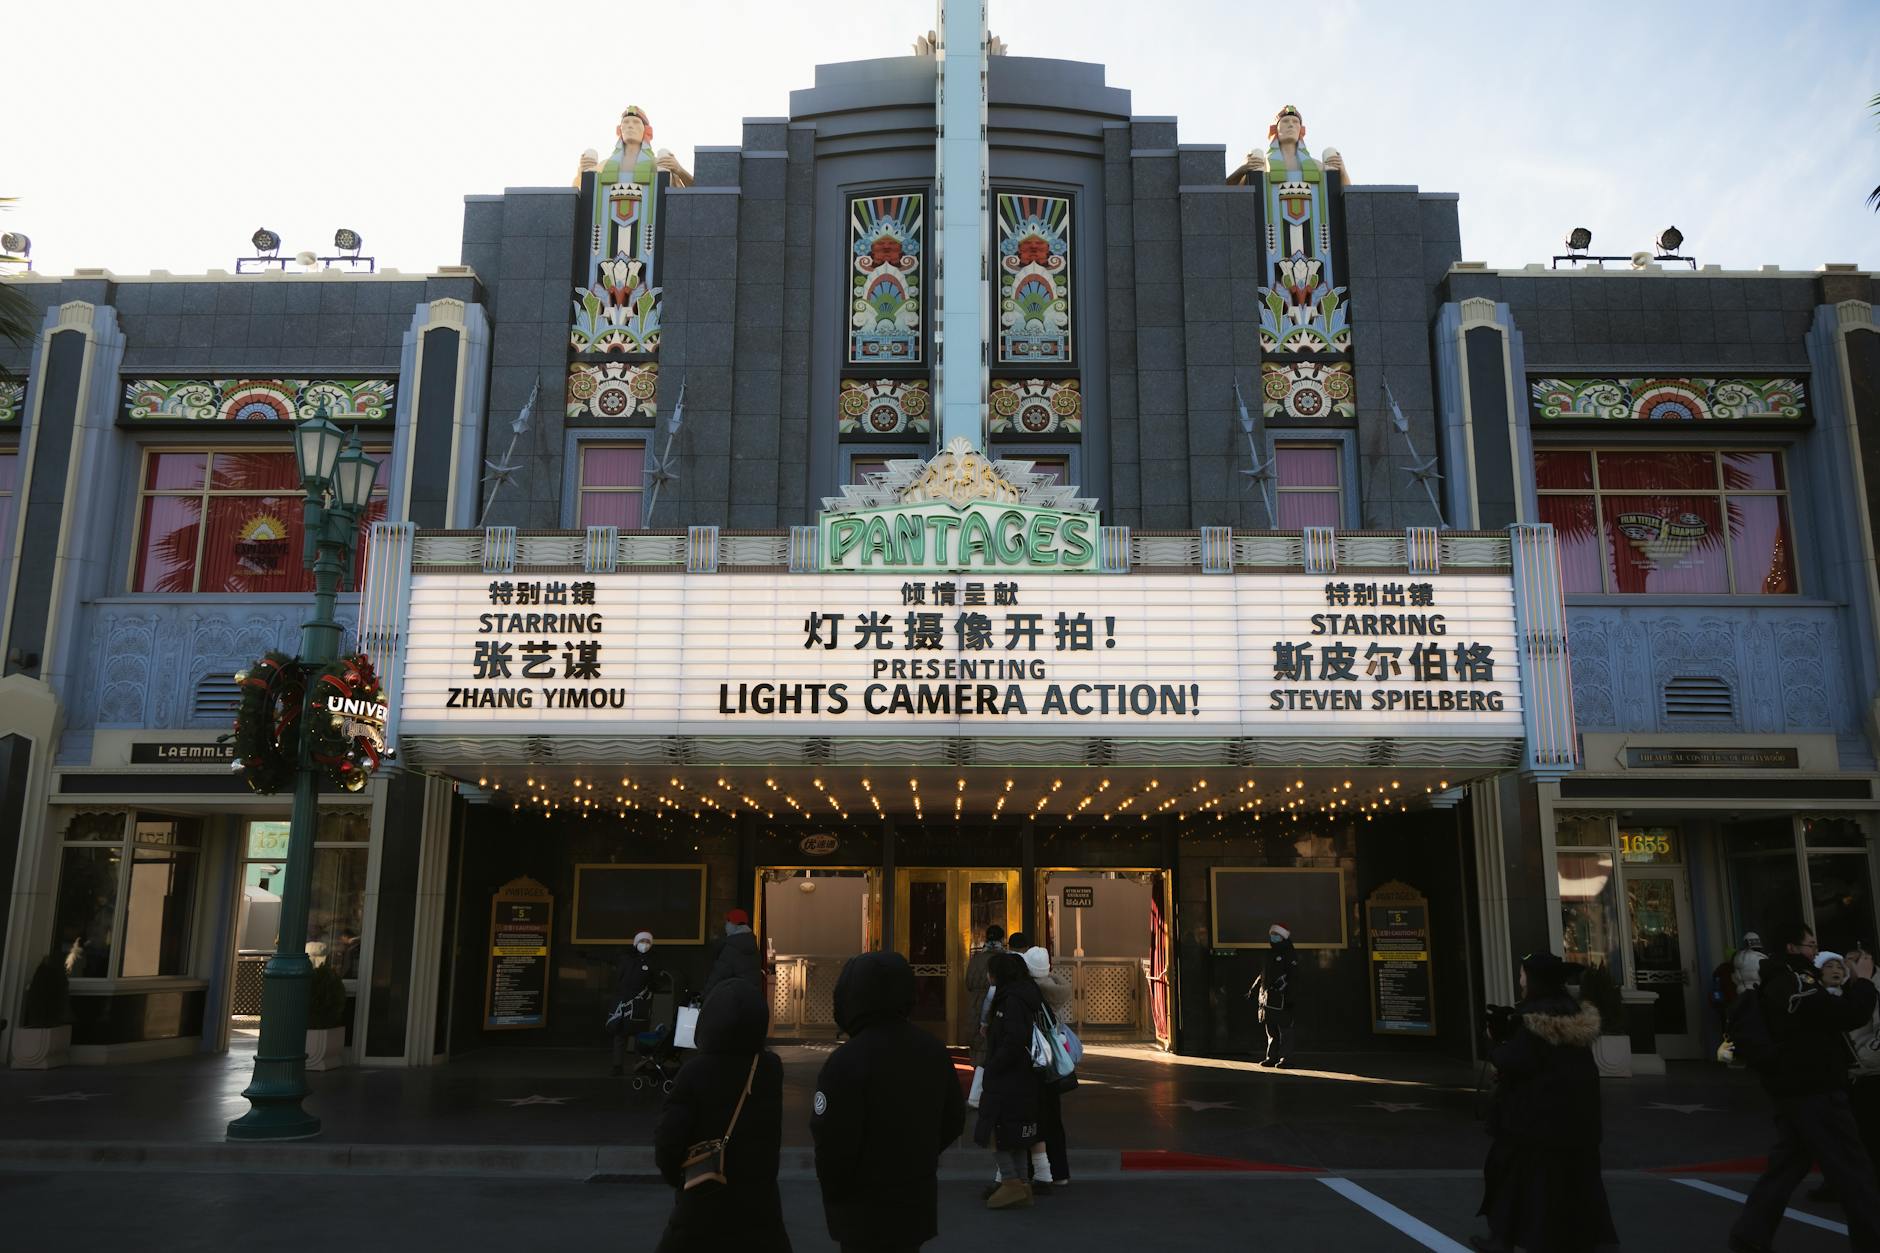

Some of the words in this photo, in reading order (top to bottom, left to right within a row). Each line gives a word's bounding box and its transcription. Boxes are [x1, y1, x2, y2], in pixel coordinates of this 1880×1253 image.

[1620, 515, 1638, 524] FILM
[830, 510, 1094, 566] PANTAGES
[1671, 526, 1705, 536] GRAPHICS
[489, 581, 596, 605] 特别出镜
[901, 582, 1018, 606] 倾情呈献
[1325, 582, 1434, 607] 特别出镜
[479, 613, 602, 633] STARRING
[1311, 614, 1446, 636] STARRING
[474, 641, 601, 680] 张艺谋
[874, 659, 1045, 680] PRESENTING
[1273, 642, 1494, 682] 斯皮尔伯格
[446, 688, 532, 708] ZHANG
[543, 688, 625, 708] YIMOU
[719, 684, 848, 714] LIGHTS
[864, 684, 1027, 715] CAMERA
[1042, 684, 1199, 715] ACTION!
[1270, 690, 1362, 711] STEVEN
[1372, 690, 1503, 712] SPIELBERG
[158, 745, 234, 758] LAEMMLE
[1619, 834, 1670, 854] 1655
